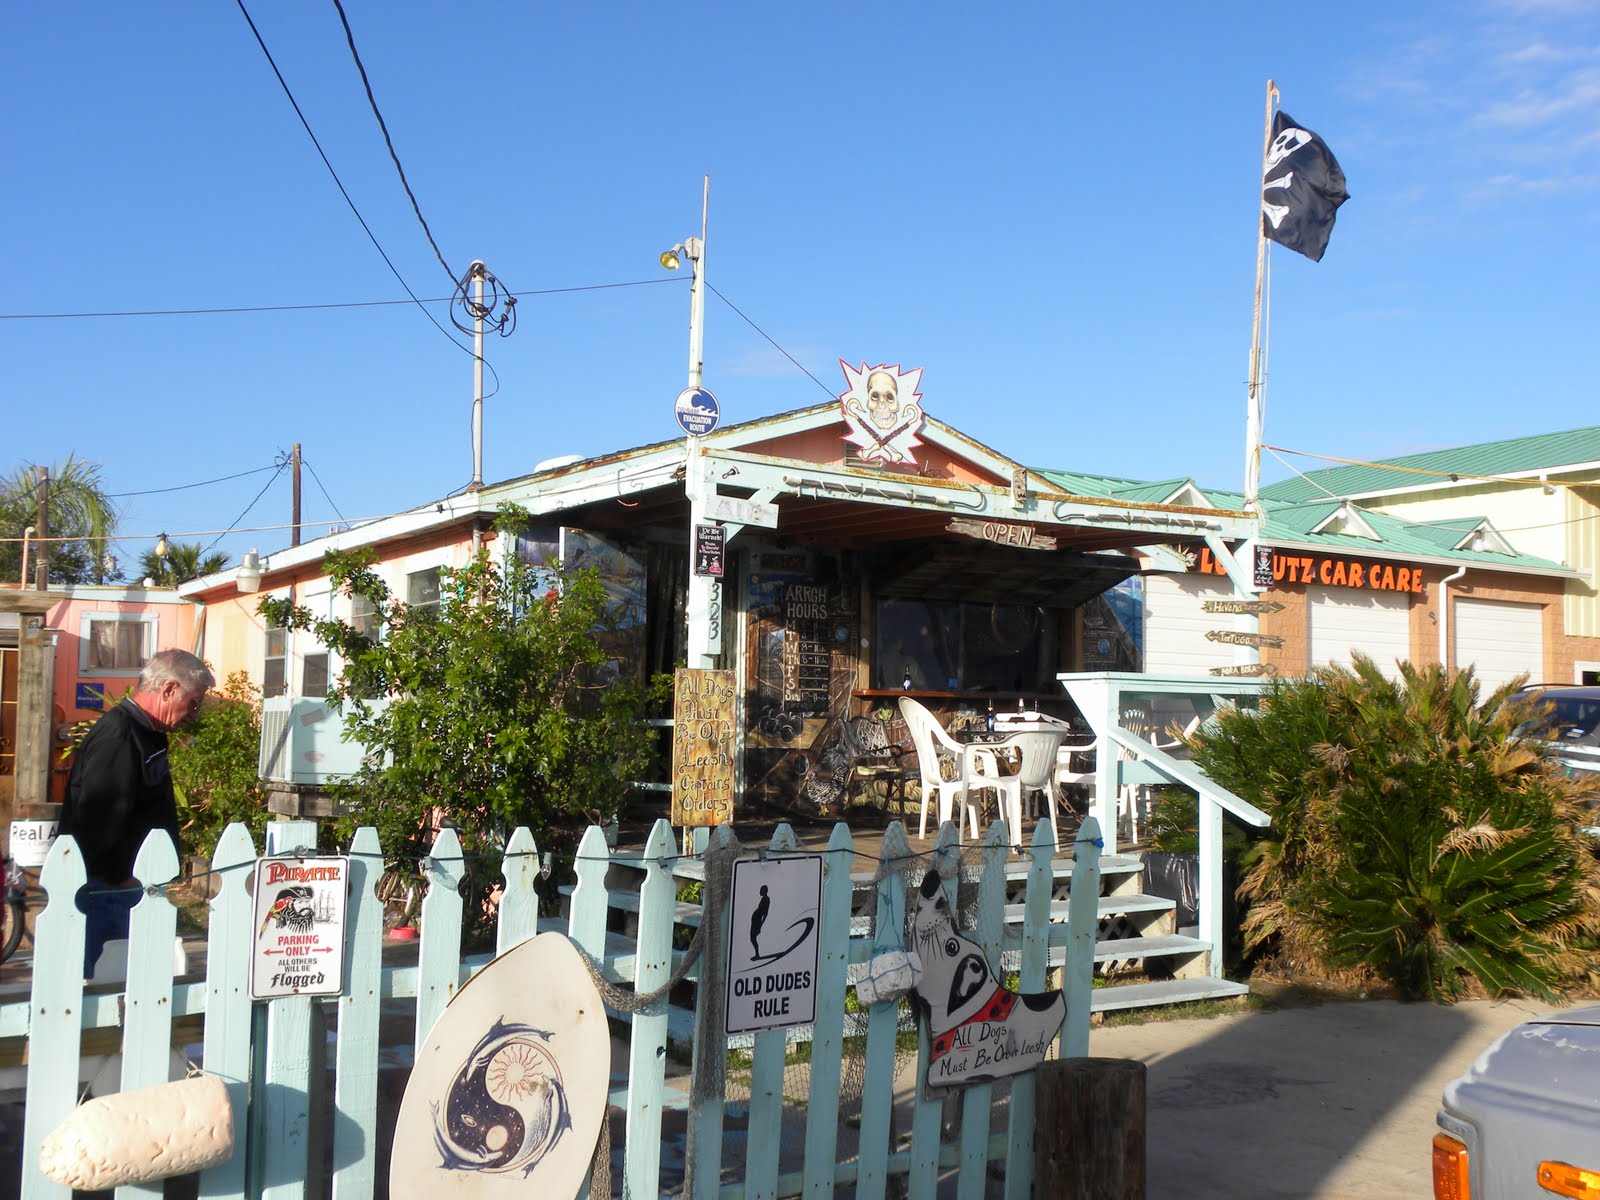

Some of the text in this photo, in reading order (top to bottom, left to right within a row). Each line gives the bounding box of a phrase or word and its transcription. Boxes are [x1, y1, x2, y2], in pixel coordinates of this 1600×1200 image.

[683, 414, 712, 425] EVACUATION
[689, 423, 706, 432] ROUTE
[982, 522, 1035, 547] OPEN
[1273, 555, 1313, 583] UTZ
[1320, 560, 1363, 588] CAR
[1369, 565, 1423, 593] CARE
[786, 584, 827, 602] ARRGH
[709, 583, 720, 640] 323
[787, 603, 827, 619] HOURS
[1213, 601, 1243, 612] Havana
[786, 642, 799, 653] W
[786, 654, 800, 665] Th
[786, 665, 794, 677] F
[681, 674, 734, 704] All Dogs
[786, 678, 796, 690] S
[682, 700, 720, 722] Must
[676, 723, 697, 744] Be
[700, 721, 718, 741] On
[678, 742, 728, 773] Leash
[680, 774, 730, 799] Captains
[681, 794, 729, 816] Orders
[13, 825, 42, 840] Real
[265, 862, 340, 886] PIRATE
[278, 935, 319, 946] PARKING
[285, 946, 311, 957] ONLY
[734, 970, 811, 997] OLD DUDES
[754, 996, 790, 1018] RULE
[952, 1022, 1007, 1047] All Dogs
[940, 1057, 968, 1076] Must
[973, 1049, 991, 1069] Be
[1021, 1030, 1044, 1055] Leash
